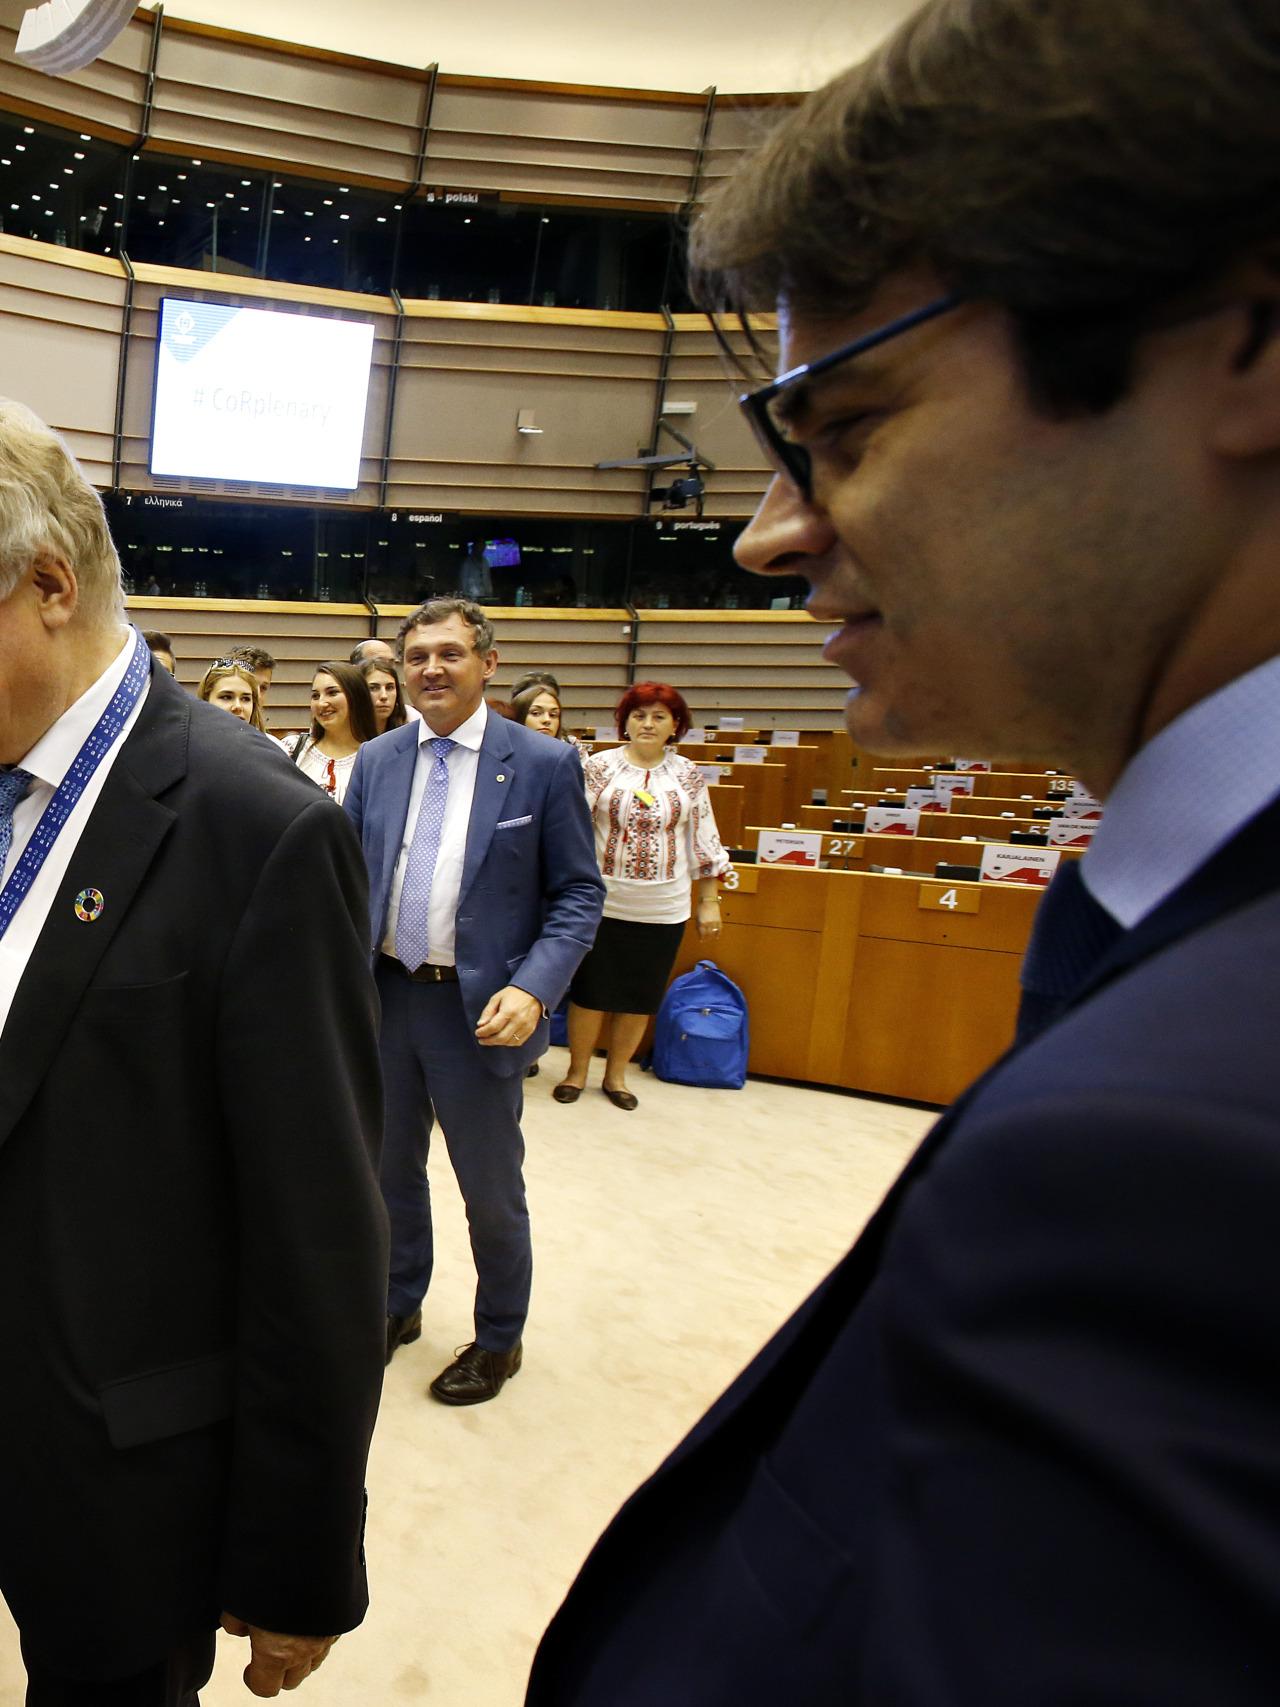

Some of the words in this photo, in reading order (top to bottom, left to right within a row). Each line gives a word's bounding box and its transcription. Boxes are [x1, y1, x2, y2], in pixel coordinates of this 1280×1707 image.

[445, 192, 479, 204] polski
[126, 495, 132, 506] 7
[144, 495, 183, 508] ελληνικά
[391, 512, 398, 522] 8
[408, 513, 443, 524] español
[1048, 779, 1076, 792] 135
[828, 839, 856, 856] 27
[723, 870, 740, 890] 3
[938, 888, 959, 910] 4
